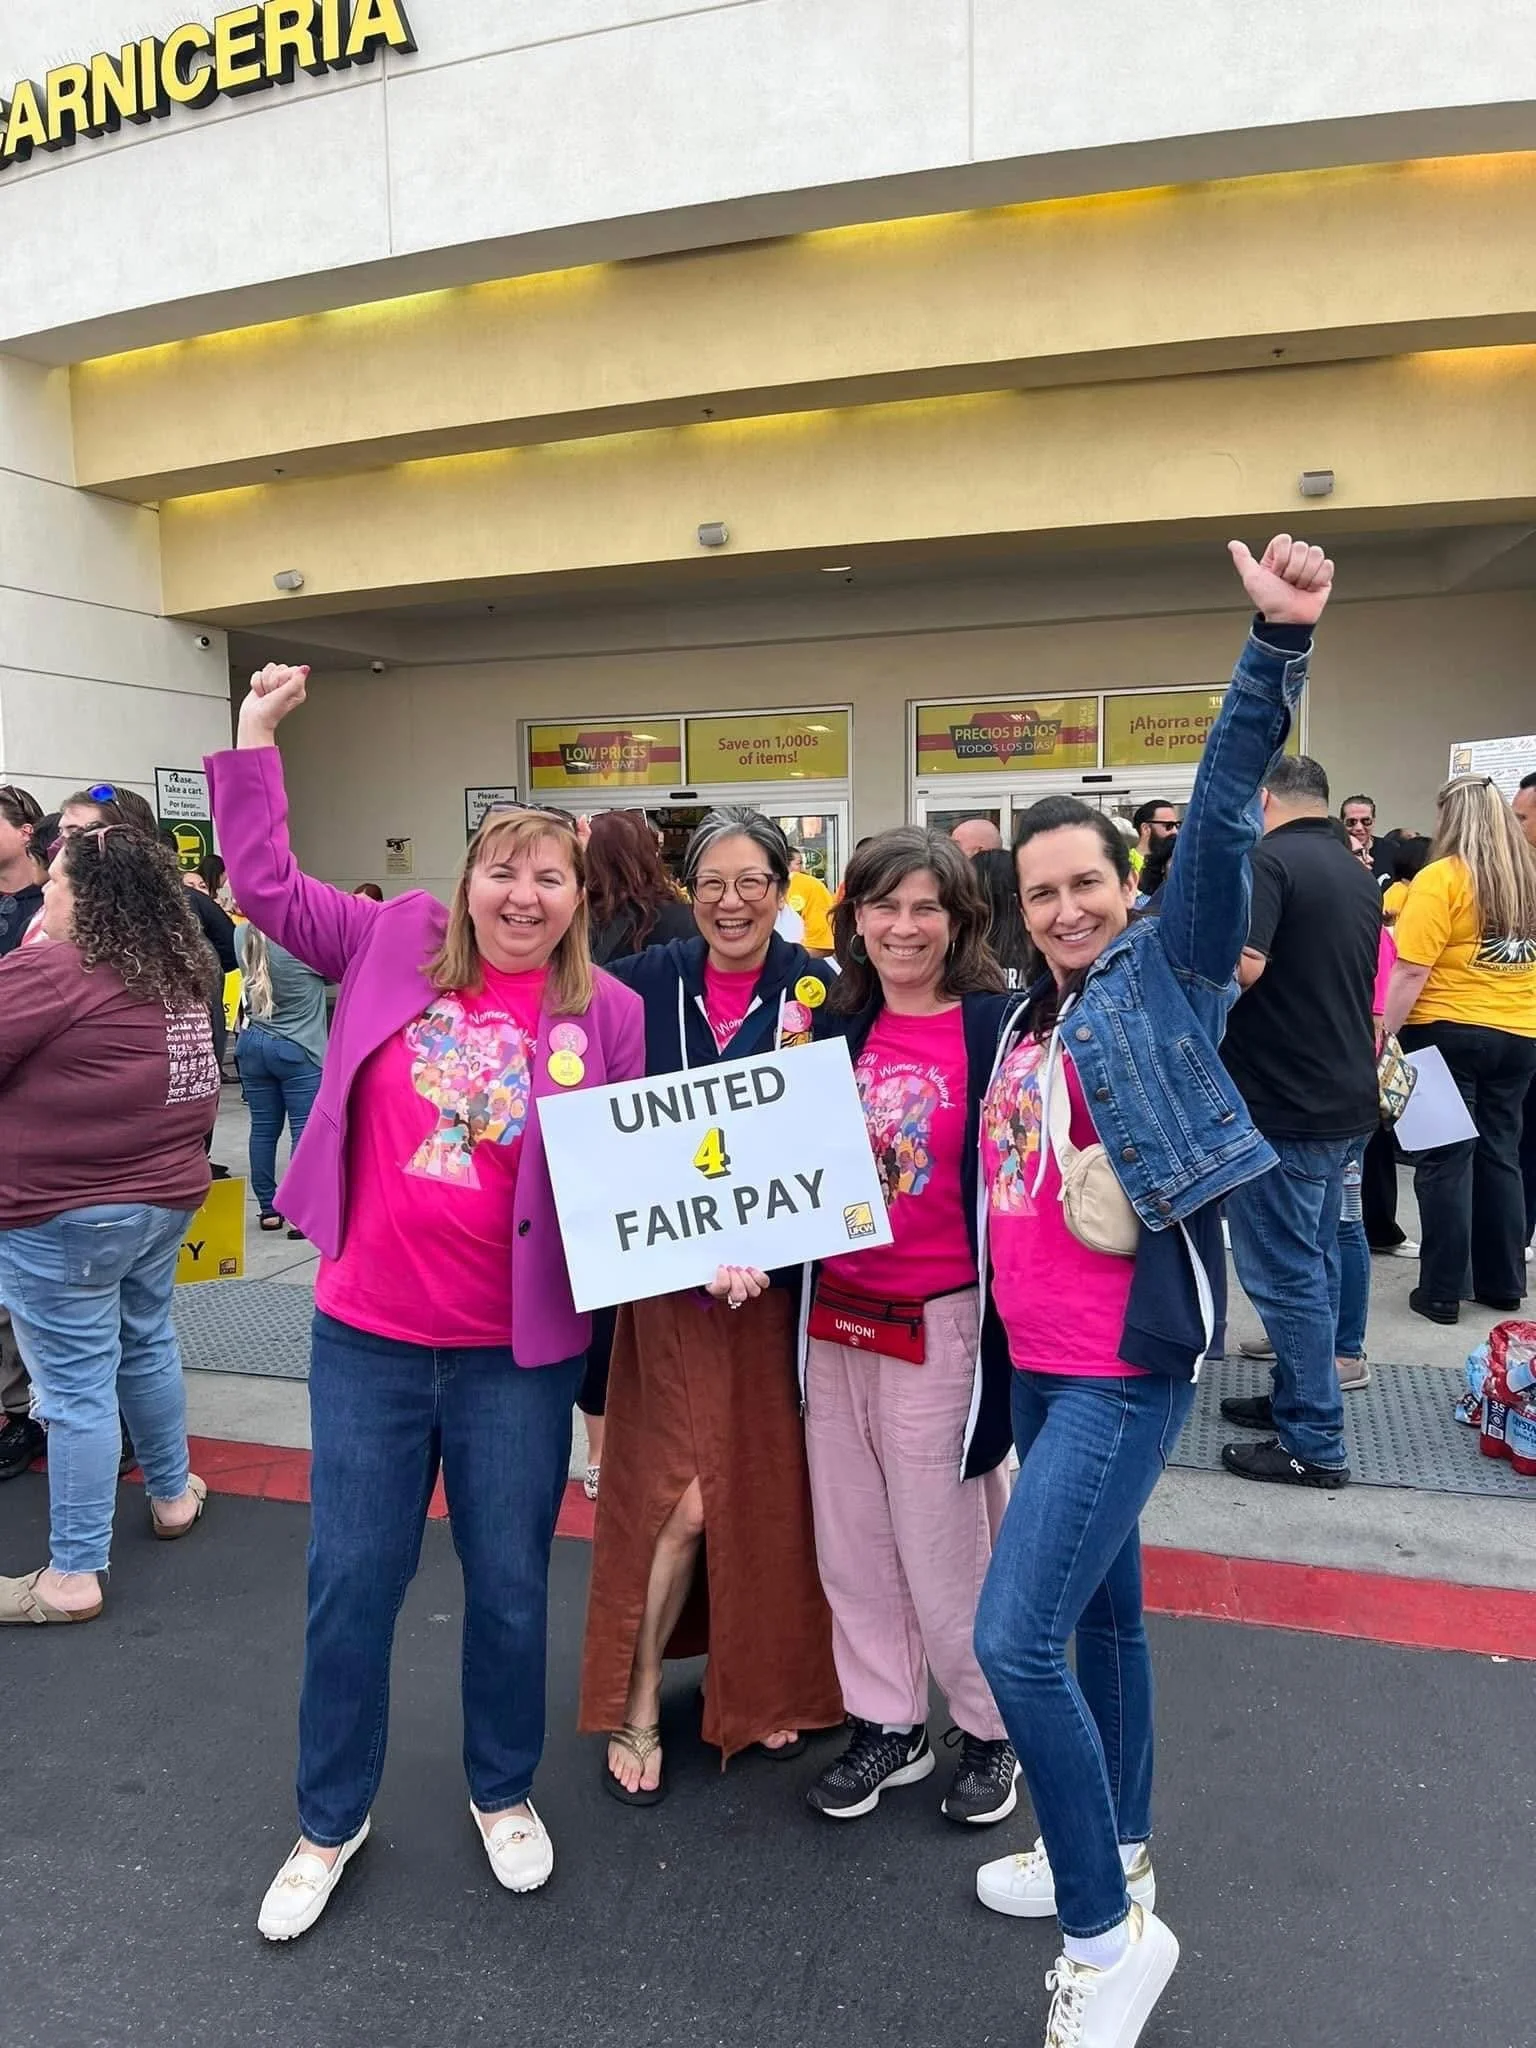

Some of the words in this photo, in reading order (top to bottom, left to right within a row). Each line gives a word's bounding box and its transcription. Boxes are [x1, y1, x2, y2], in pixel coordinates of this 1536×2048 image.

[0, 0, 409, 162] ARNICERIA
[955, 726, 1010, 740] PRECIOS
[1013, 724, 1057, 737] BAJOS
[1130, 715, 1189, 734] ¡Ahorra
[718, 738, 749, 750] Save
[753, 739, 770, 749] on
[775, 734, 819, 749] 1,000s
[1001, 742, 1022, 752] LOS
[1144, 732, 1164, 747] de
[566, 747, 597, 761] LOW
[600, 745, 647, 759] PRICES
[738, 752, 753, 765] of
[756, 751, 798, 765] items!
[164, 784, 181, 793] Take
[879, 1063, 924, 1079] Women's
[609, 1066, 786, 1134] UNITED
[692, 1127, 731, 1180] 4
[615, 1195, 722, 1252] FAIR
[733, 1168, 825, 1226] PAY
[835, 1319, 875, 1339] UNION!
[1491, 1400, 1506, 1413] 35
